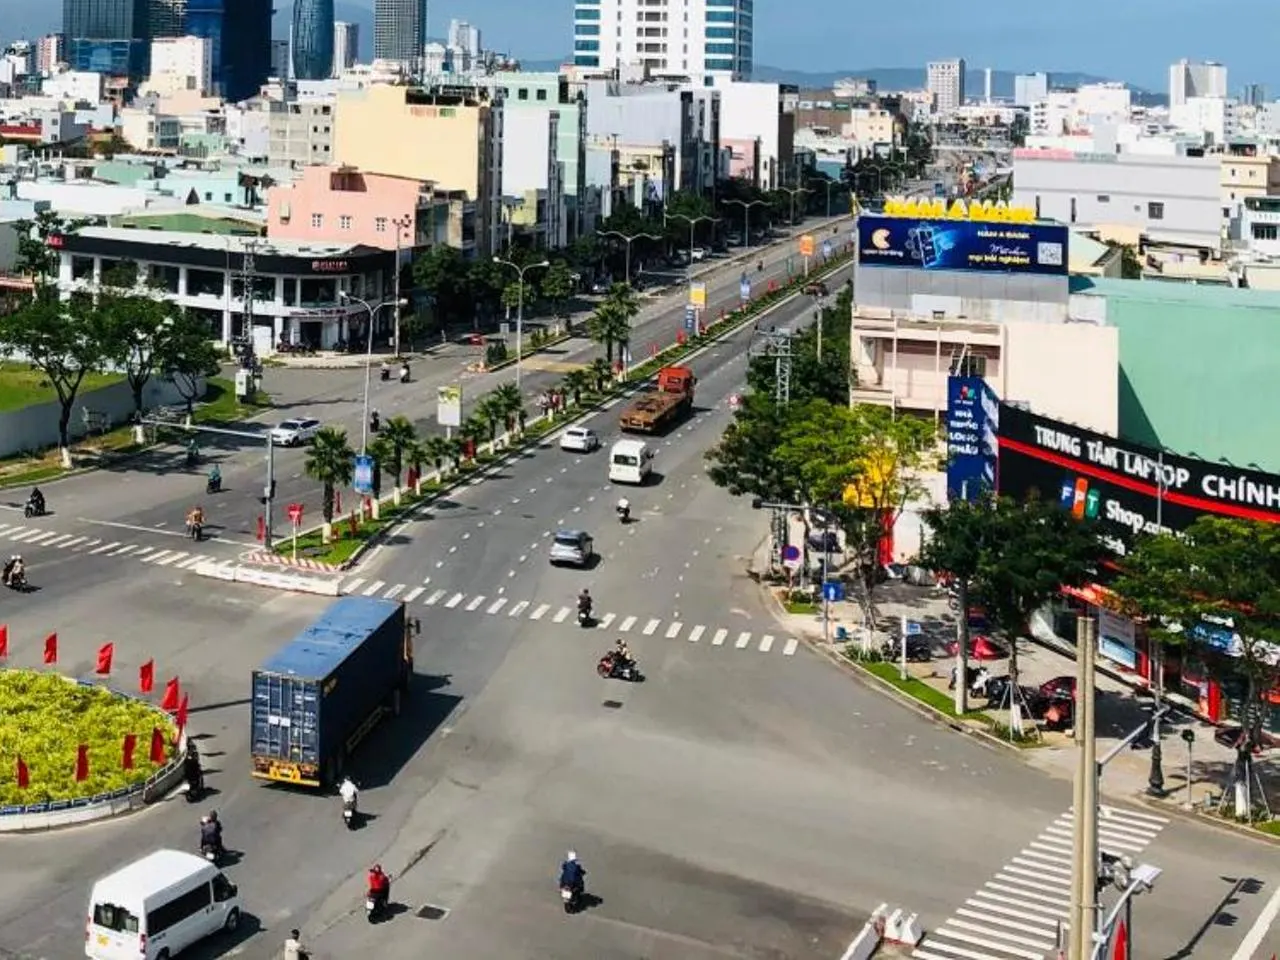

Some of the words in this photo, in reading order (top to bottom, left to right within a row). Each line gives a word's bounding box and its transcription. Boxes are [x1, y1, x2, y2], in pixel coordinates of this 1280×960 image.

[1034, 425, 1081, 457] TRUNG
[1124, 453, 1190, 488] LAPTOP
[1201, 474, 1280, 509] CHÍNH
[1060, 482, 1100, 515] FPT
